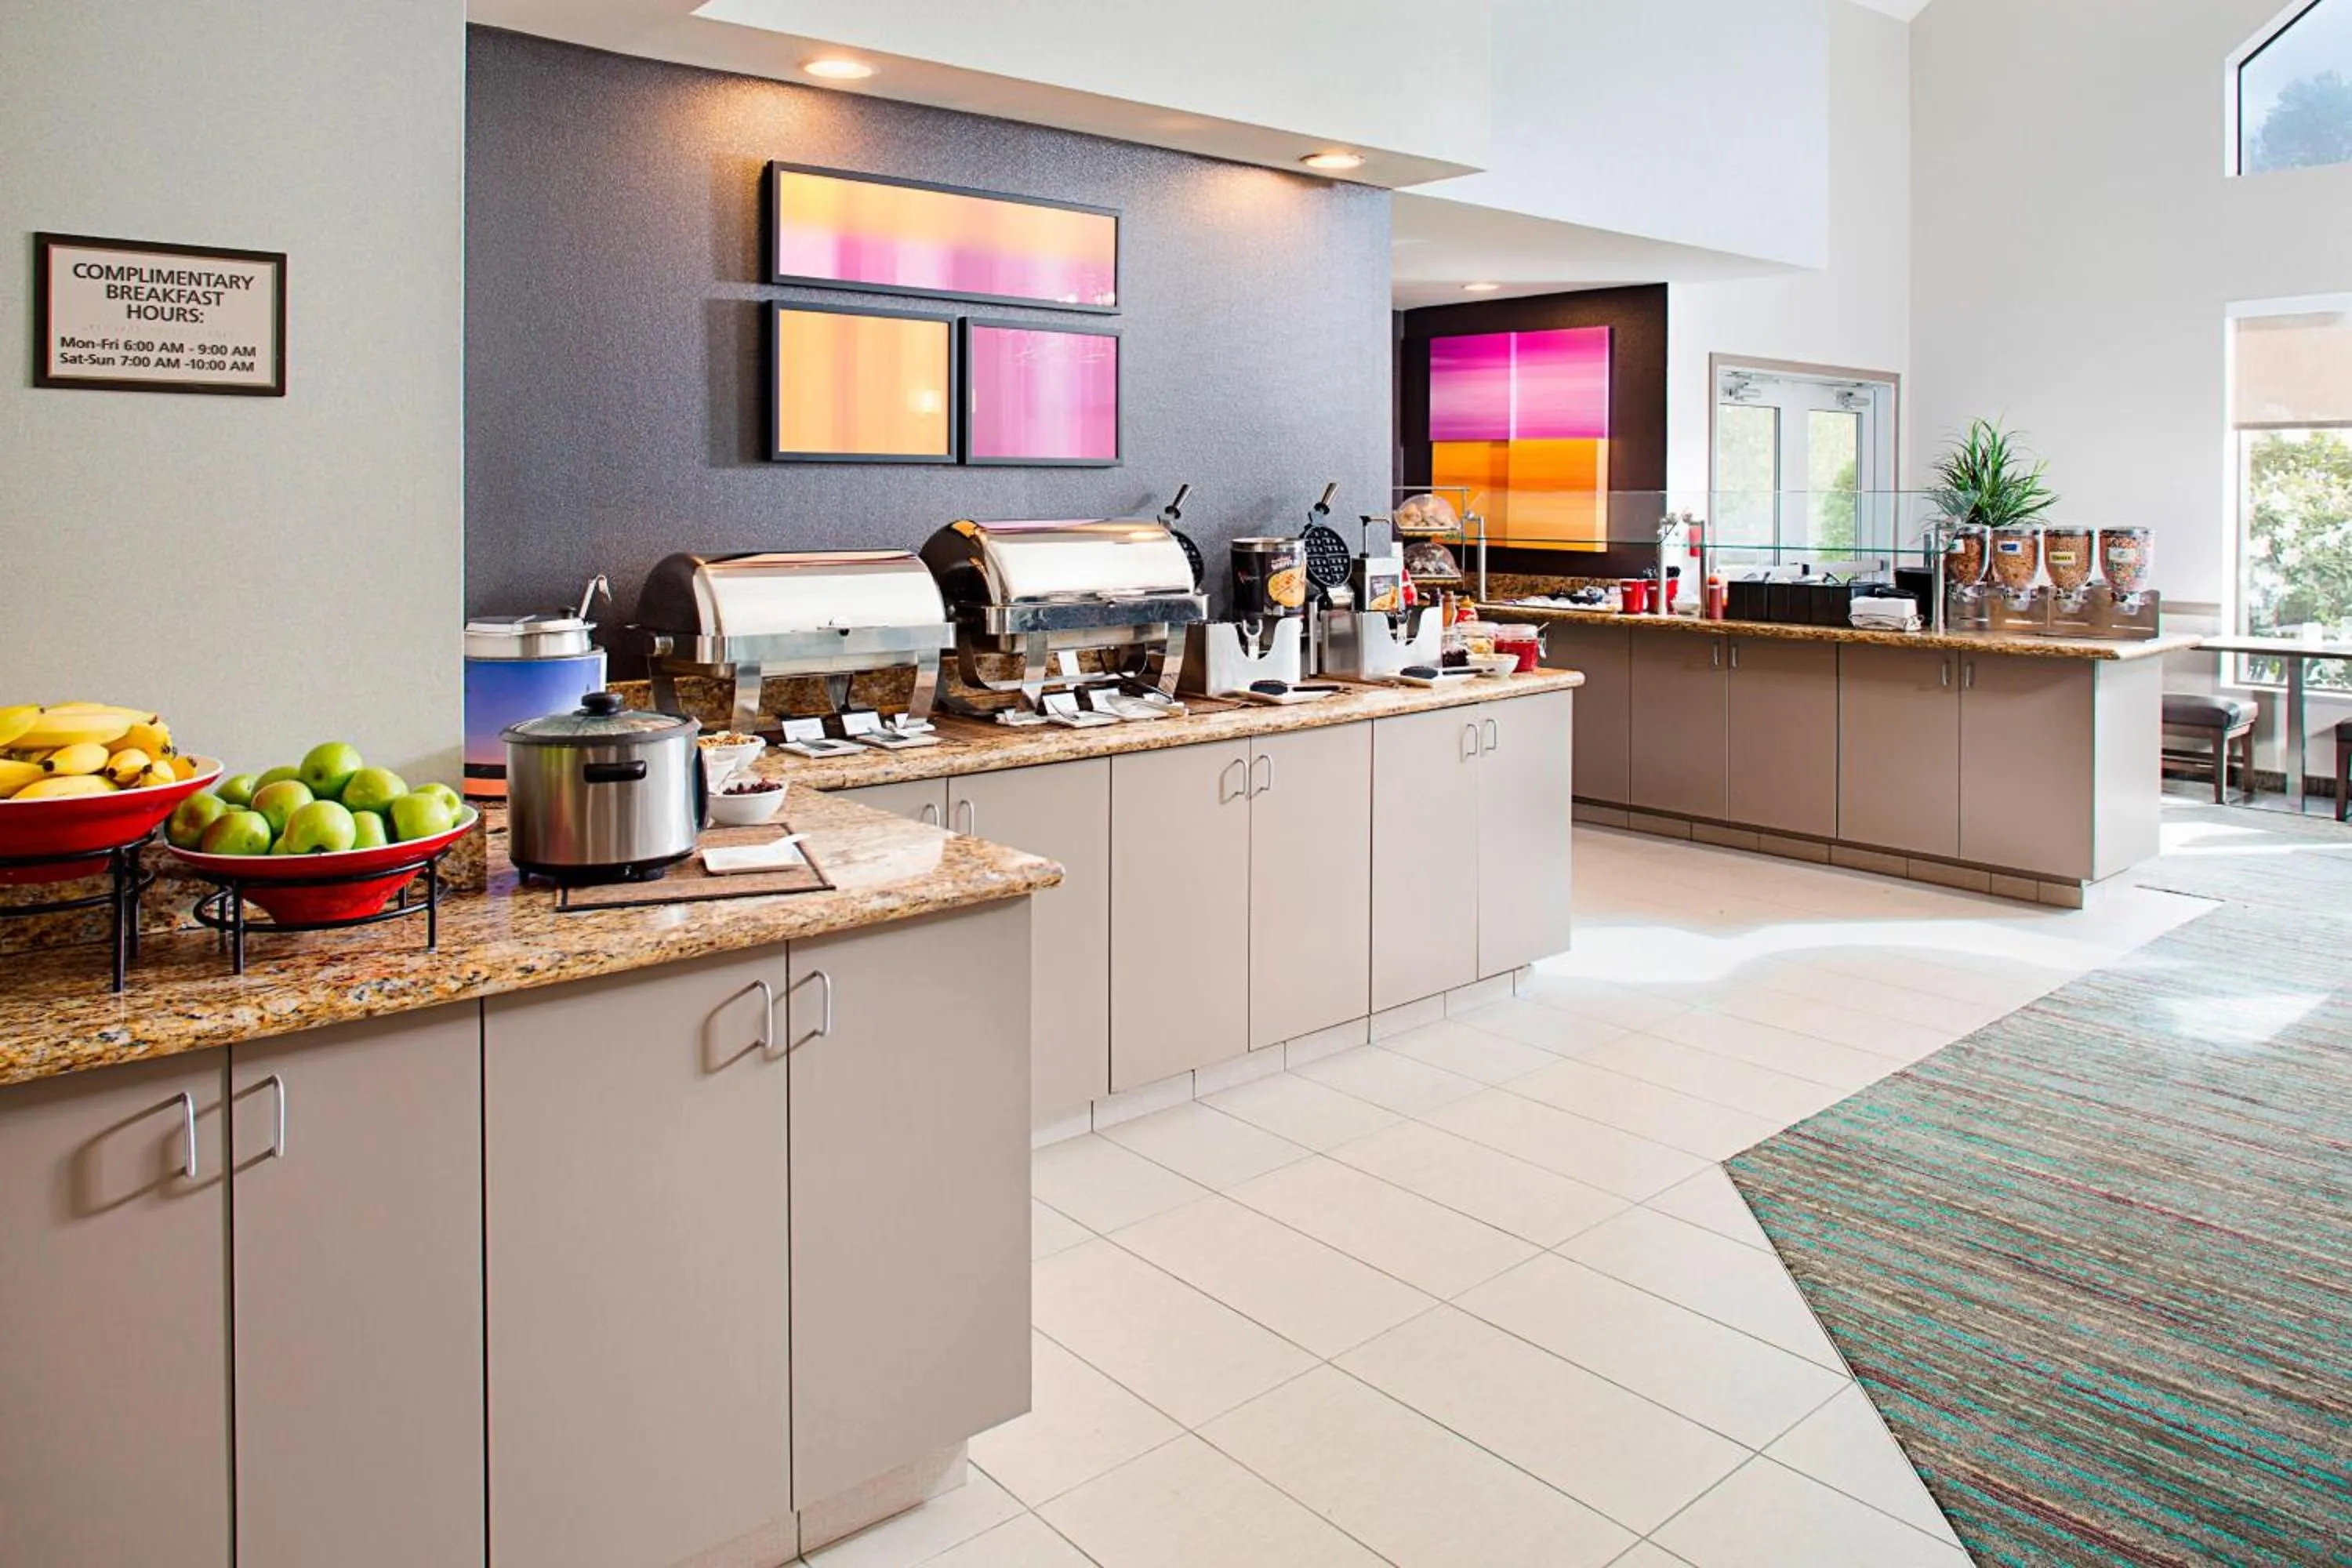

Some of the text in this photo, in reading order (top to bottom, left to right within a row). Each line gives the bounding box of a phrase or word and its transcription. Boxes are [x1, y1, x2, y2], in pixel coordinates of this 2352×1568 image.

[73, 263, 255, 290] COMPLIMENTARY
[106, 285, 225, 307] BREAKFAST
[126, 304, 205, 323] HOURS:
[60, 336, 118, 350] Mon-Fri
[123, 339, 154, 352] 6:00
[159, 342, 184, 354] AM
[198, 343, 228, 356] 9:00
[231, 346, 256, 358] AM
[60, 352, 115, 366] Sat-Sun
[120, 355, 151, 368] 7:00
[154, 358, 180, 369] AM
[229, 361, 255, 372] AM
